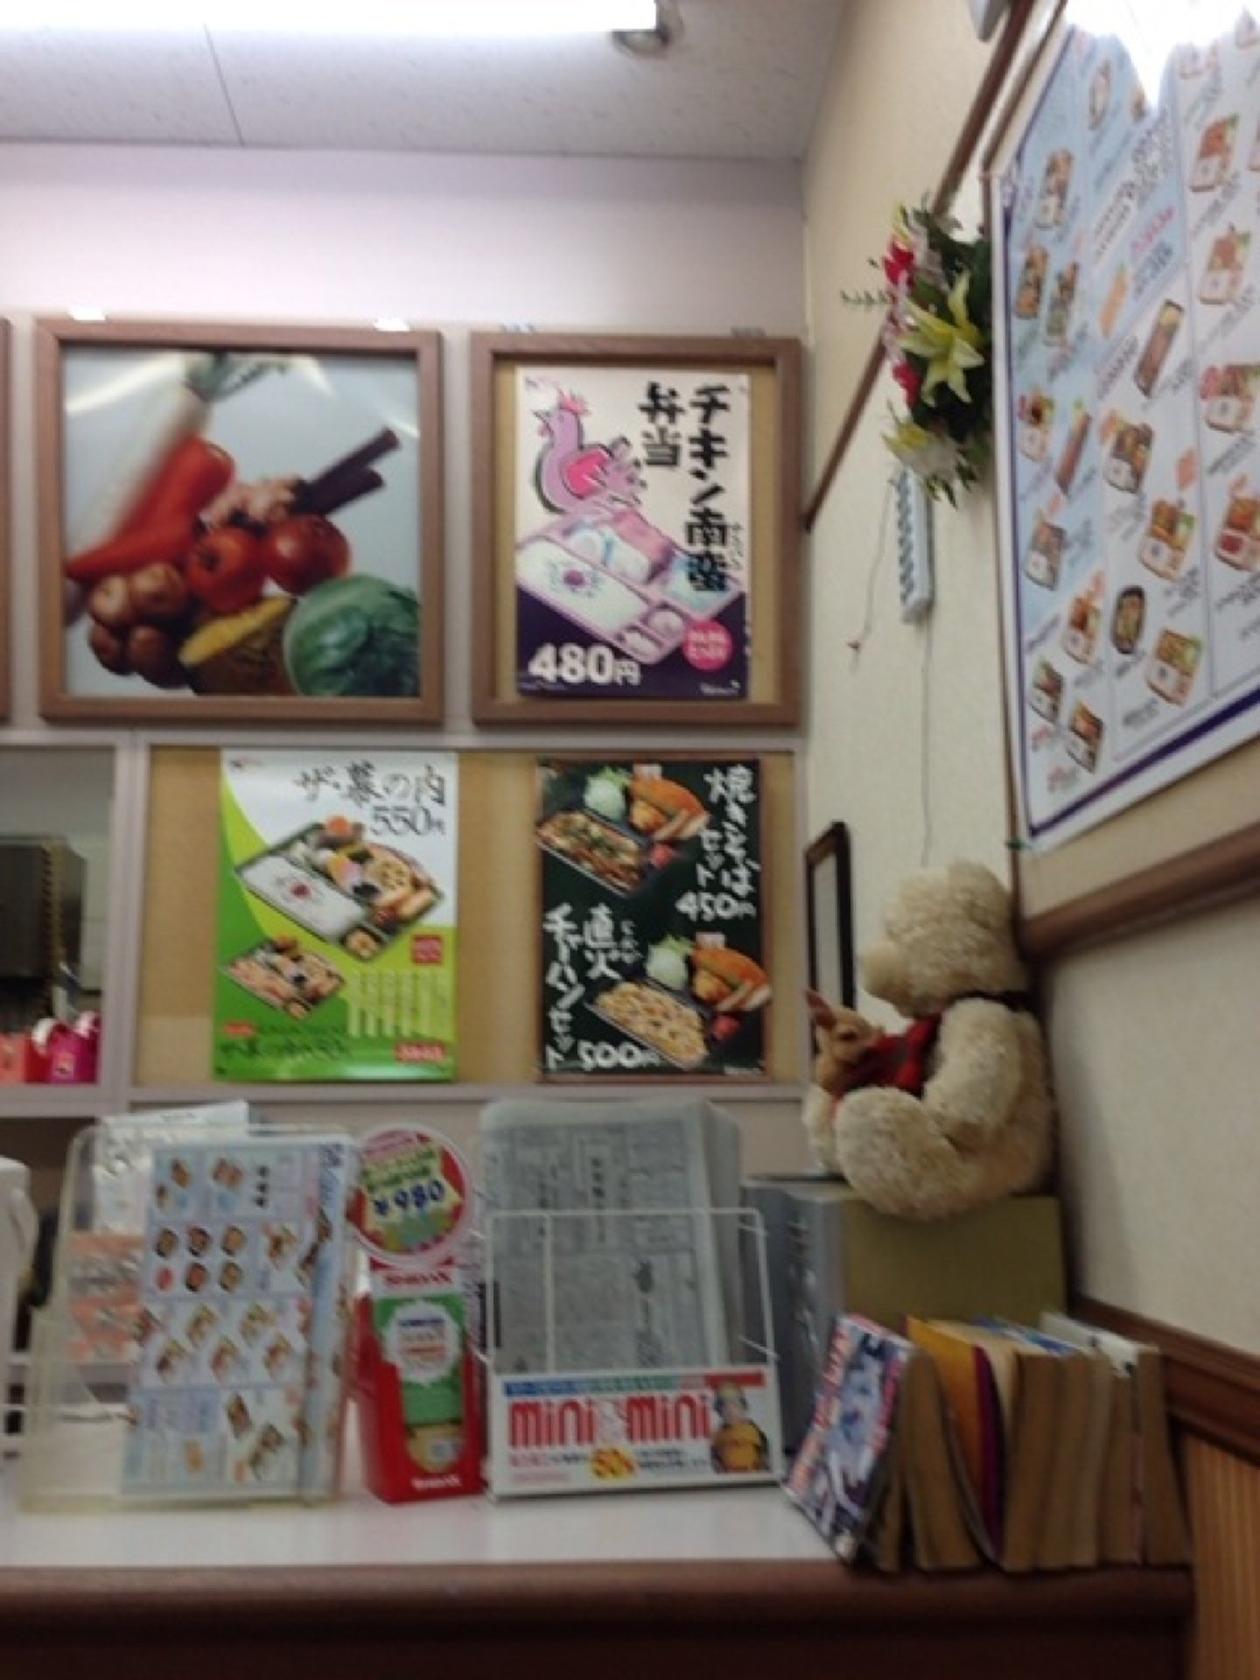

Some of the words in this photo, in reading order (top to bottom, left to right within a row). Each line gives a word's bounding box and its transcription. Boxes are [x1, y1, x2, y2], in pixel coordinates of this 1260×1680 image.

[638, 381, 686, 468] 弁当
[686, 384, 731, 592] チキン南蛮
[527, 643, 641, 688] 480円
